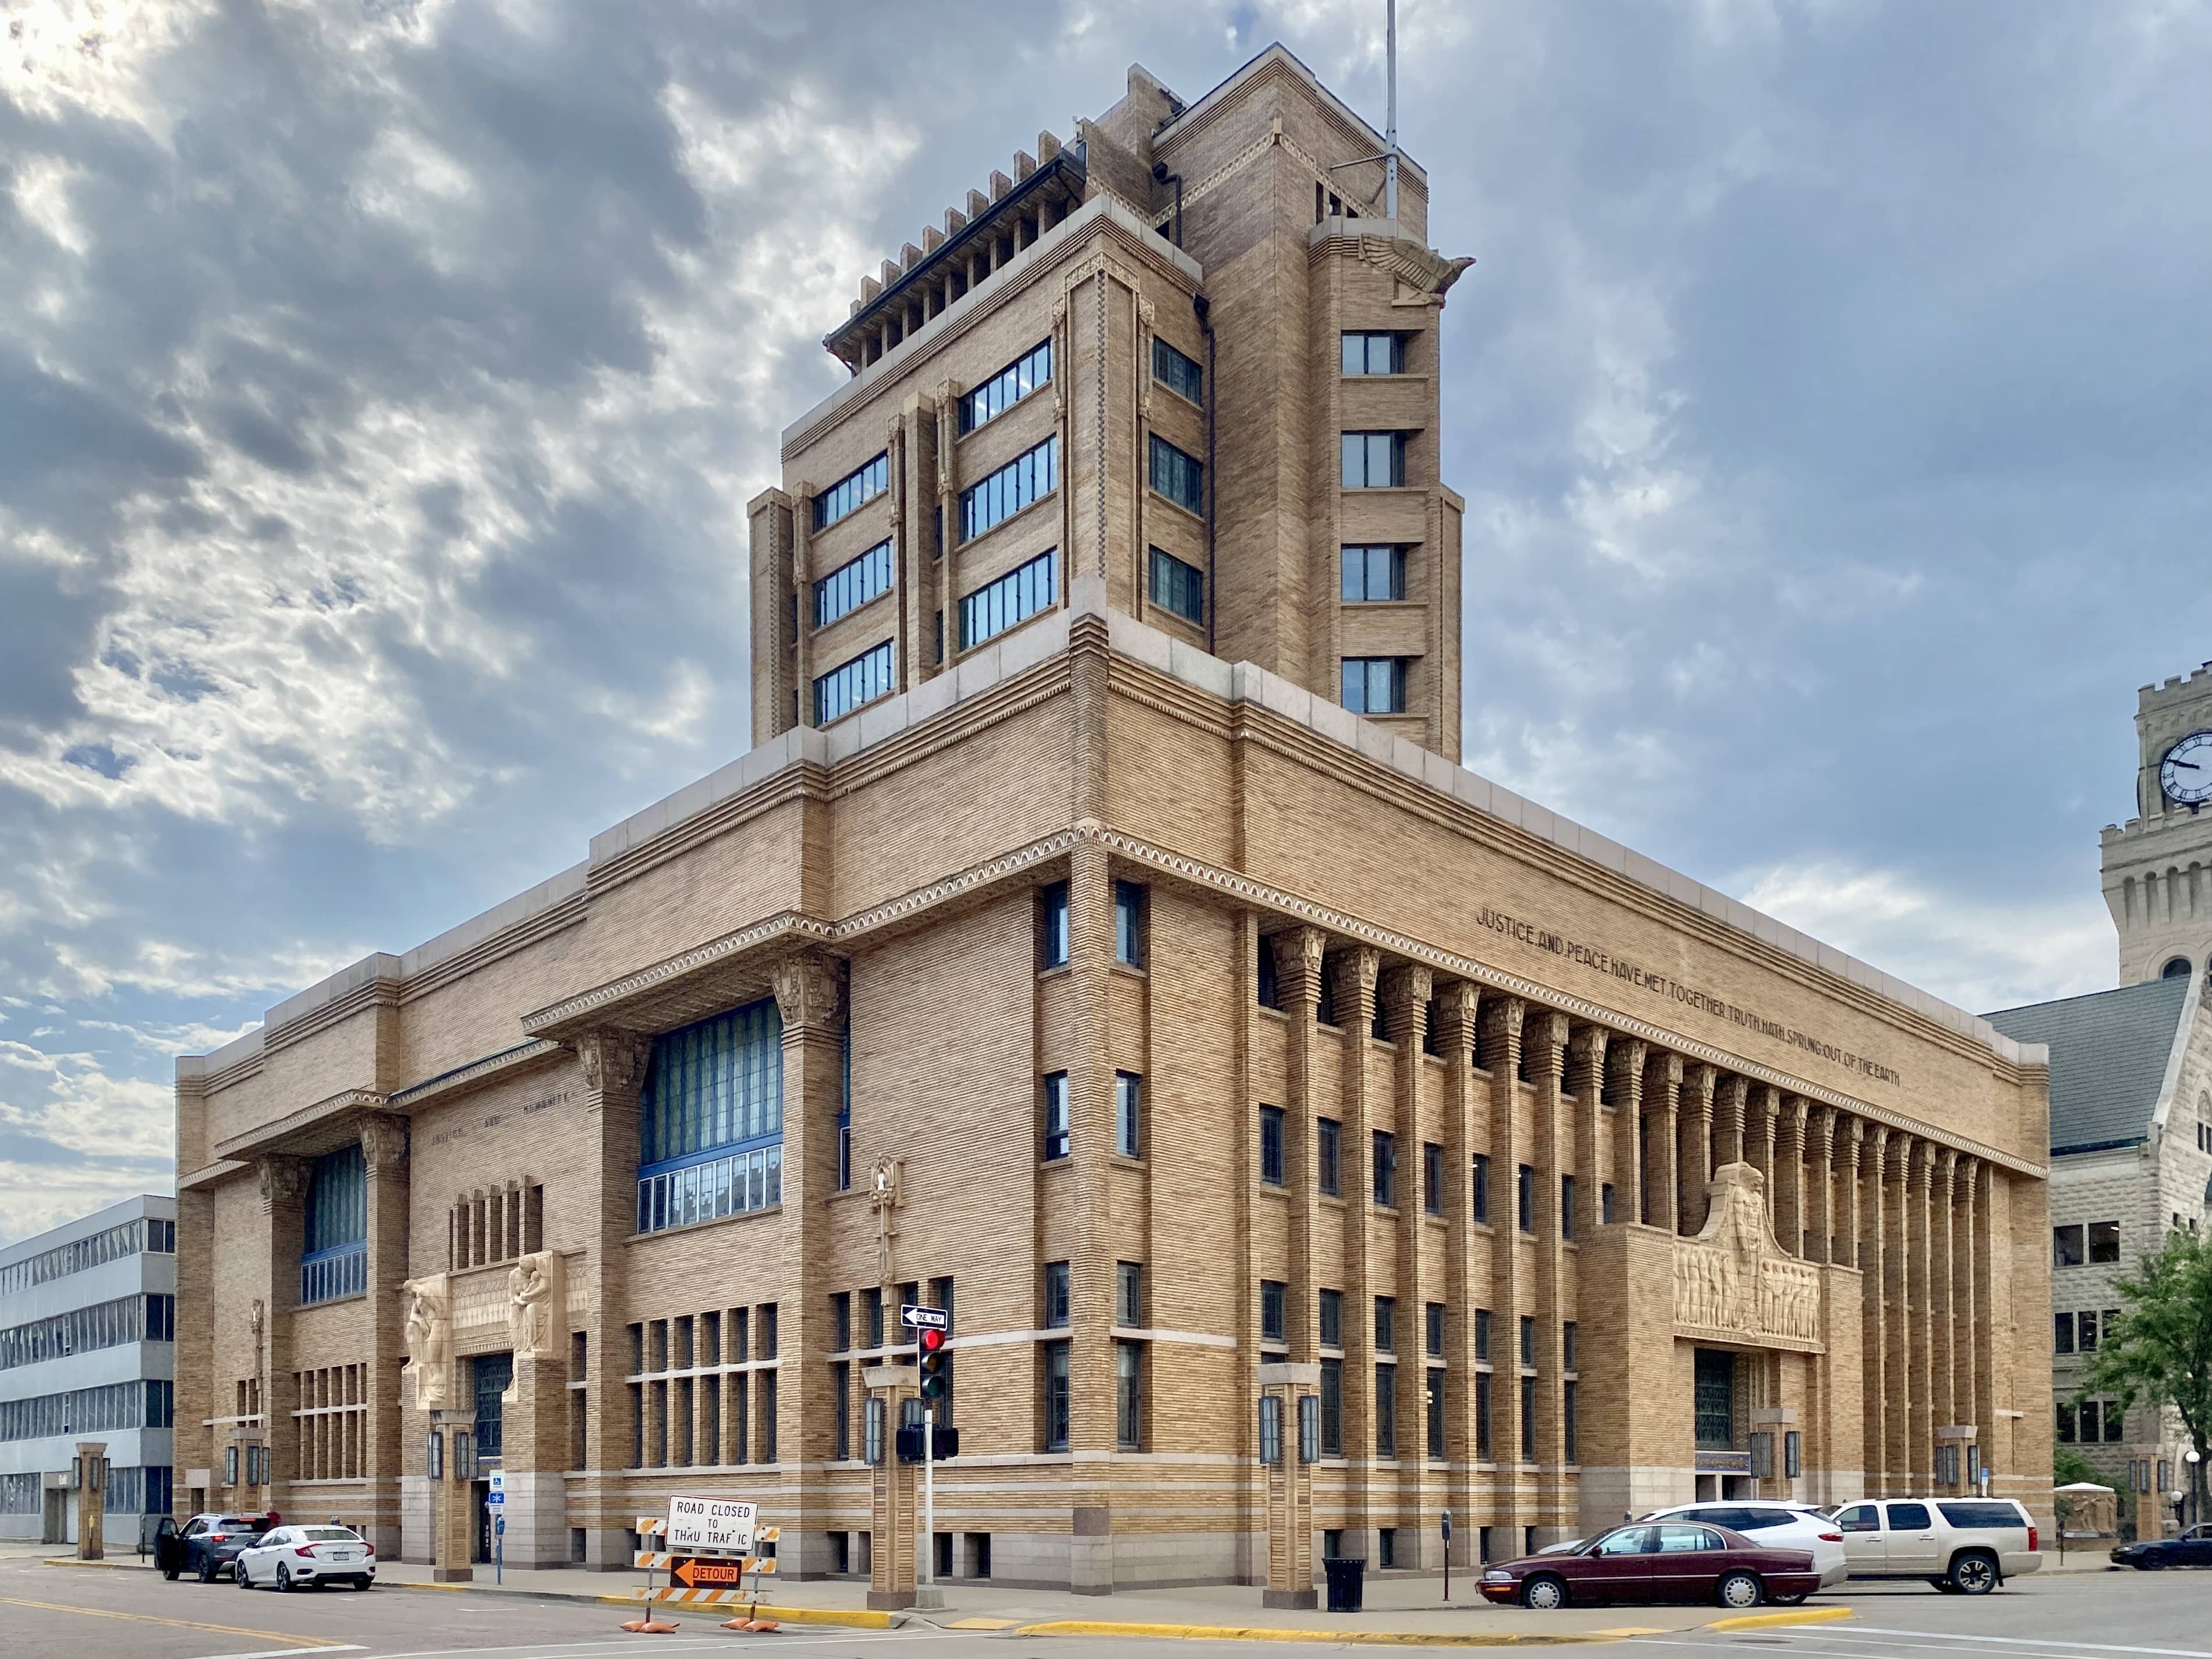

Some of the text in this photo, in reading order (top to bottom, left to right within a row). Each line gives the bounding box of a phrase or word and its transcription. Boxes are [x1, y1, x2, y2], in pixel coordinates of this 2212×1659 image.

[1477, 908, 1900, 1087] JUSTICE AND PEACE HAVE MET TOGETHER TRUTH HATH SPRUNG OUT OF THE EARTH
[916, 1313, 927, 1321] ONE
[677, 1501, 750, 1518] ROAD CLOSED
[708, 1519, 718, 1528] TO
[675, 1529, 747, 1545] THRU TRAFIC
[692, 1567, 735, 1580] DETOUR
